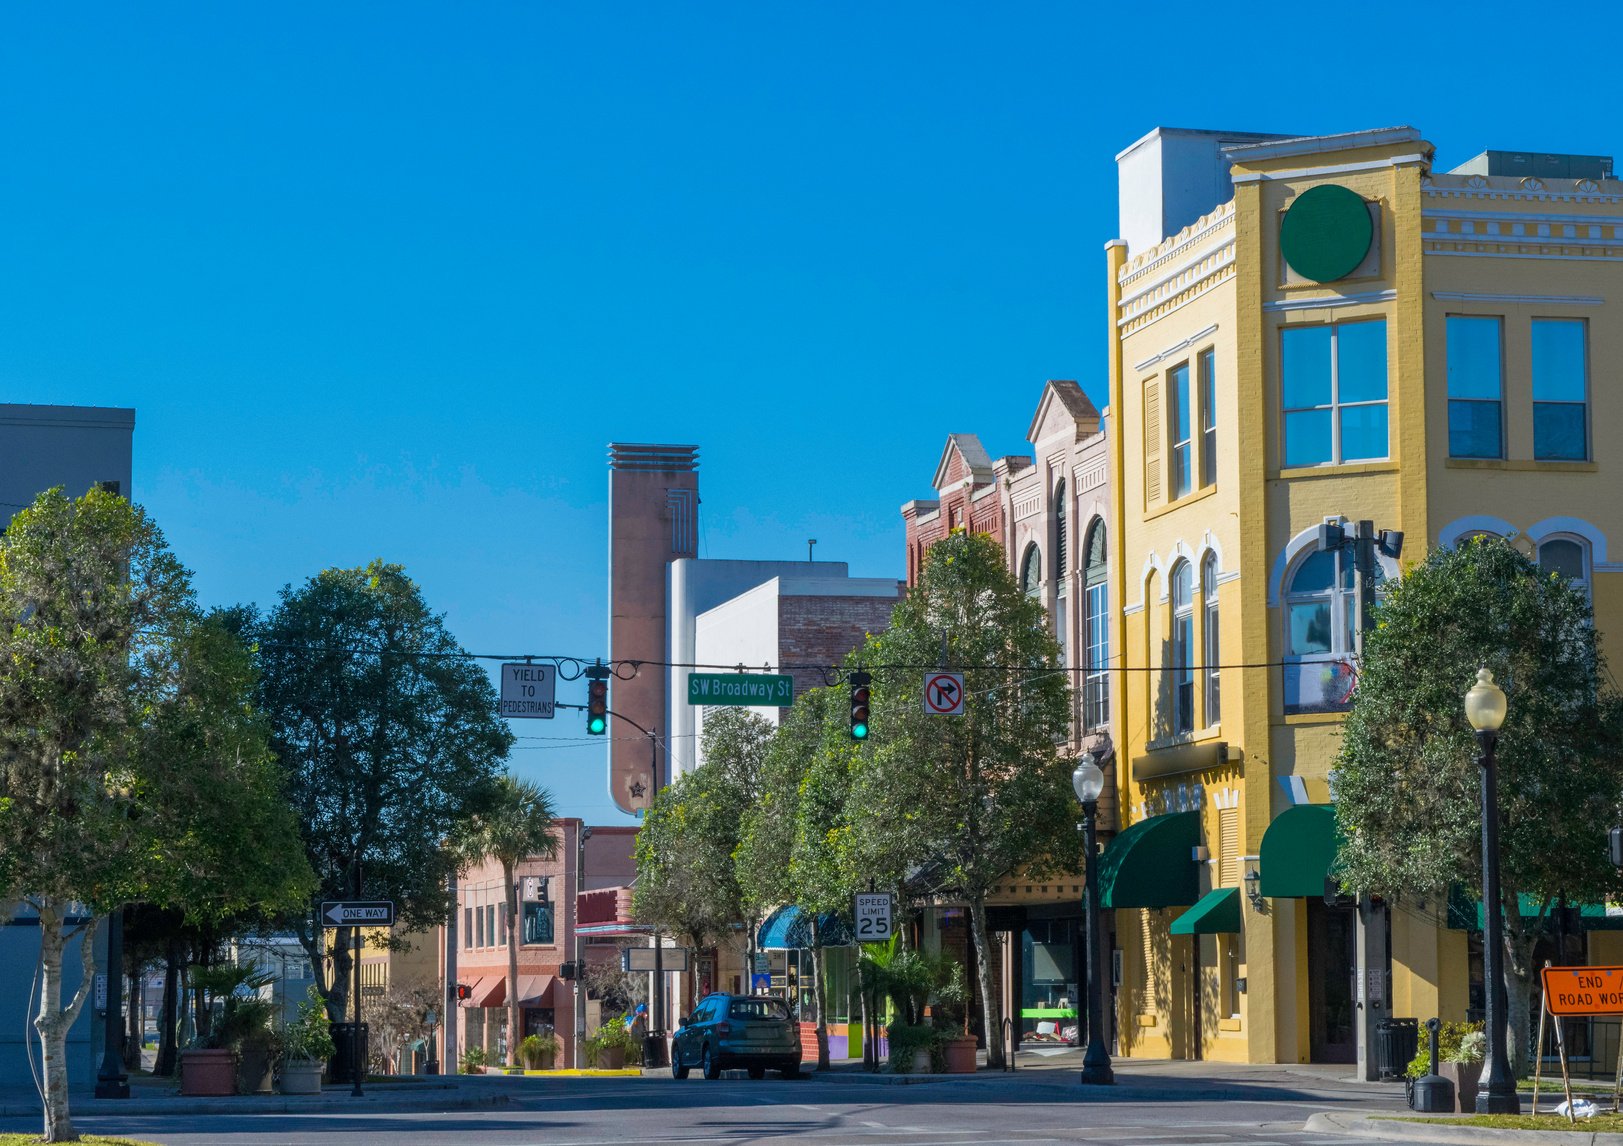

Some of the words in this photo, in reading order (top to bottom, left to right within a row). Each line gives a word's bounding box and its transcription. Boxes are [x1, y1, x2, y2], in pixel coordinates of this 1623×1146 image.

[513, 669, 545, 681] YIELD
[521, 685, 535, 697] TO
[692, 679, 709, 695] SW
[713, 679, 774, 701] Broadway
[778, 681, 790, 696] St
[503, 700, 552, 714] PEDESTRIANS
[859, 898, 888, 906] SPEED
[343, 909, 362, 918] ONE
[365, 909, 385, 918] WAY
[860, 918, 888, 934] 25
[1578, 976, 1603, 988] END
[1559, 993, 1593, 1006] ROAD
